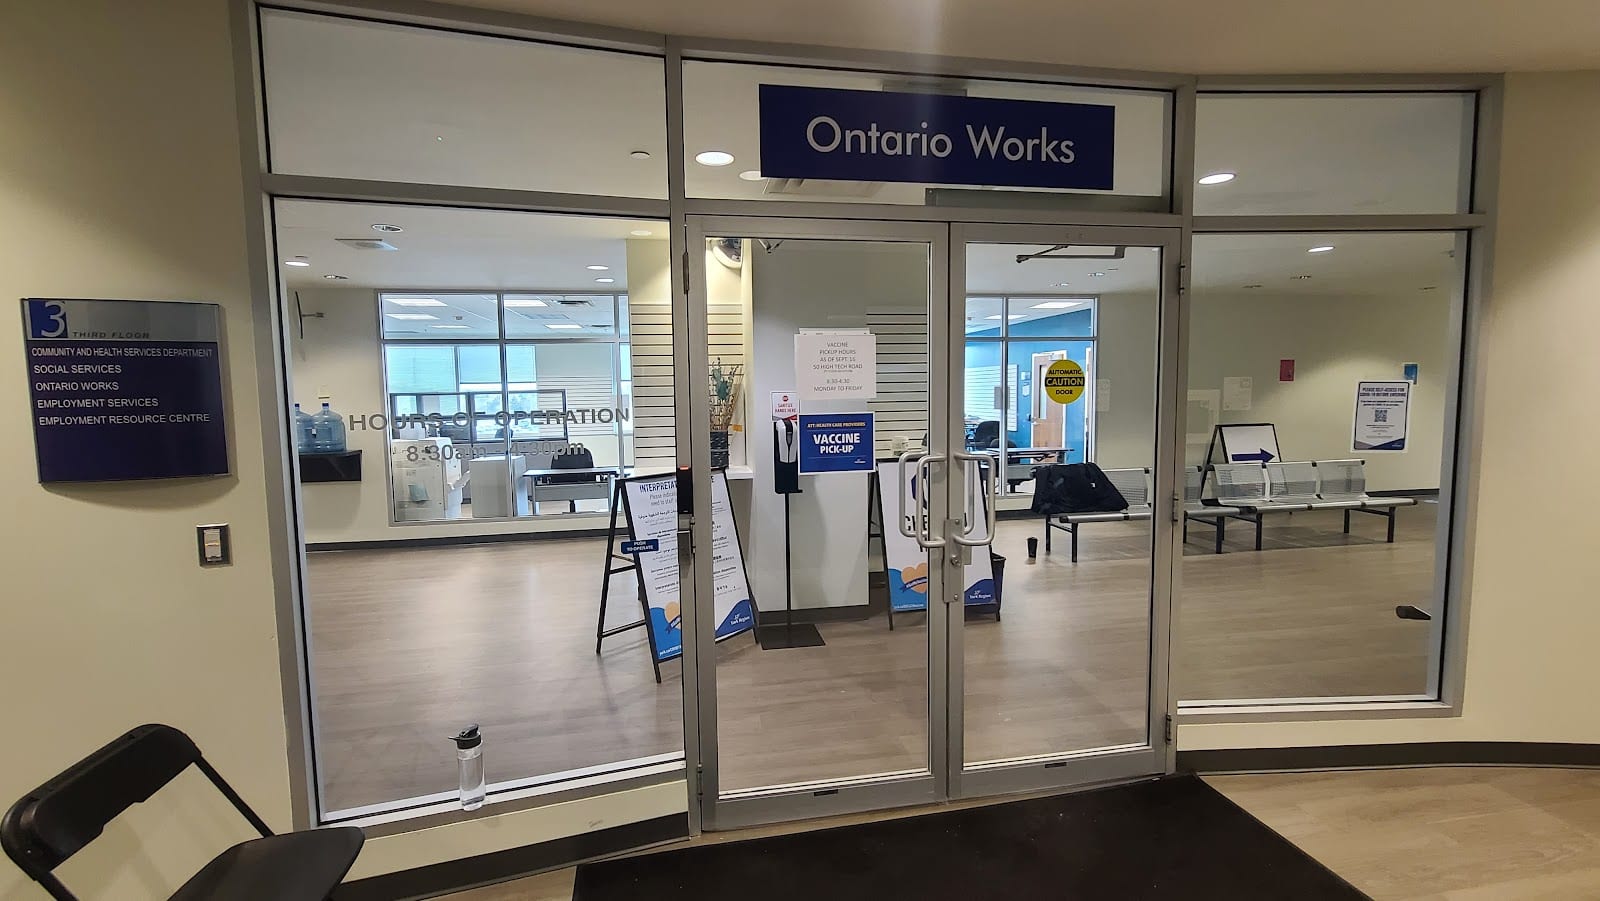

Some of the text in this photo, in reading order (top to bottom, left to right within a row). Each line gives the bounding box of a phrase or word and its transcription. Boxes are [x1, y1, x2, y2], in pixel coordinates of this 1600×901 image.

[806, 116, 1076, 164] Ontario Works
[41, 301, 65, 338] 3
[31, 347, 213, 358] COMMUNITY AND HEALTH SERVICES DEPARTMENT
[34, 365, 122, 374] SOCIAL SERVICES
[35, 382, 119, 391] ONTARIO WORKS
[1046, 378, 1084, 386] CAUTION
[37, 398, 159, 409] EMPLOYMENT SERVICES
[39, 413, 211, 426] EMPLOYMENT RESOURCE CENTRE
[349, 407, 630, 432] HOURS OF OPERATION
[813, 433, 861, 445] VACCINE
[406, 444, 487, 462] 8:30am
[509, 441, 585, 460] 4:30pm
[820, 445, 854, 454] PICK-UP
